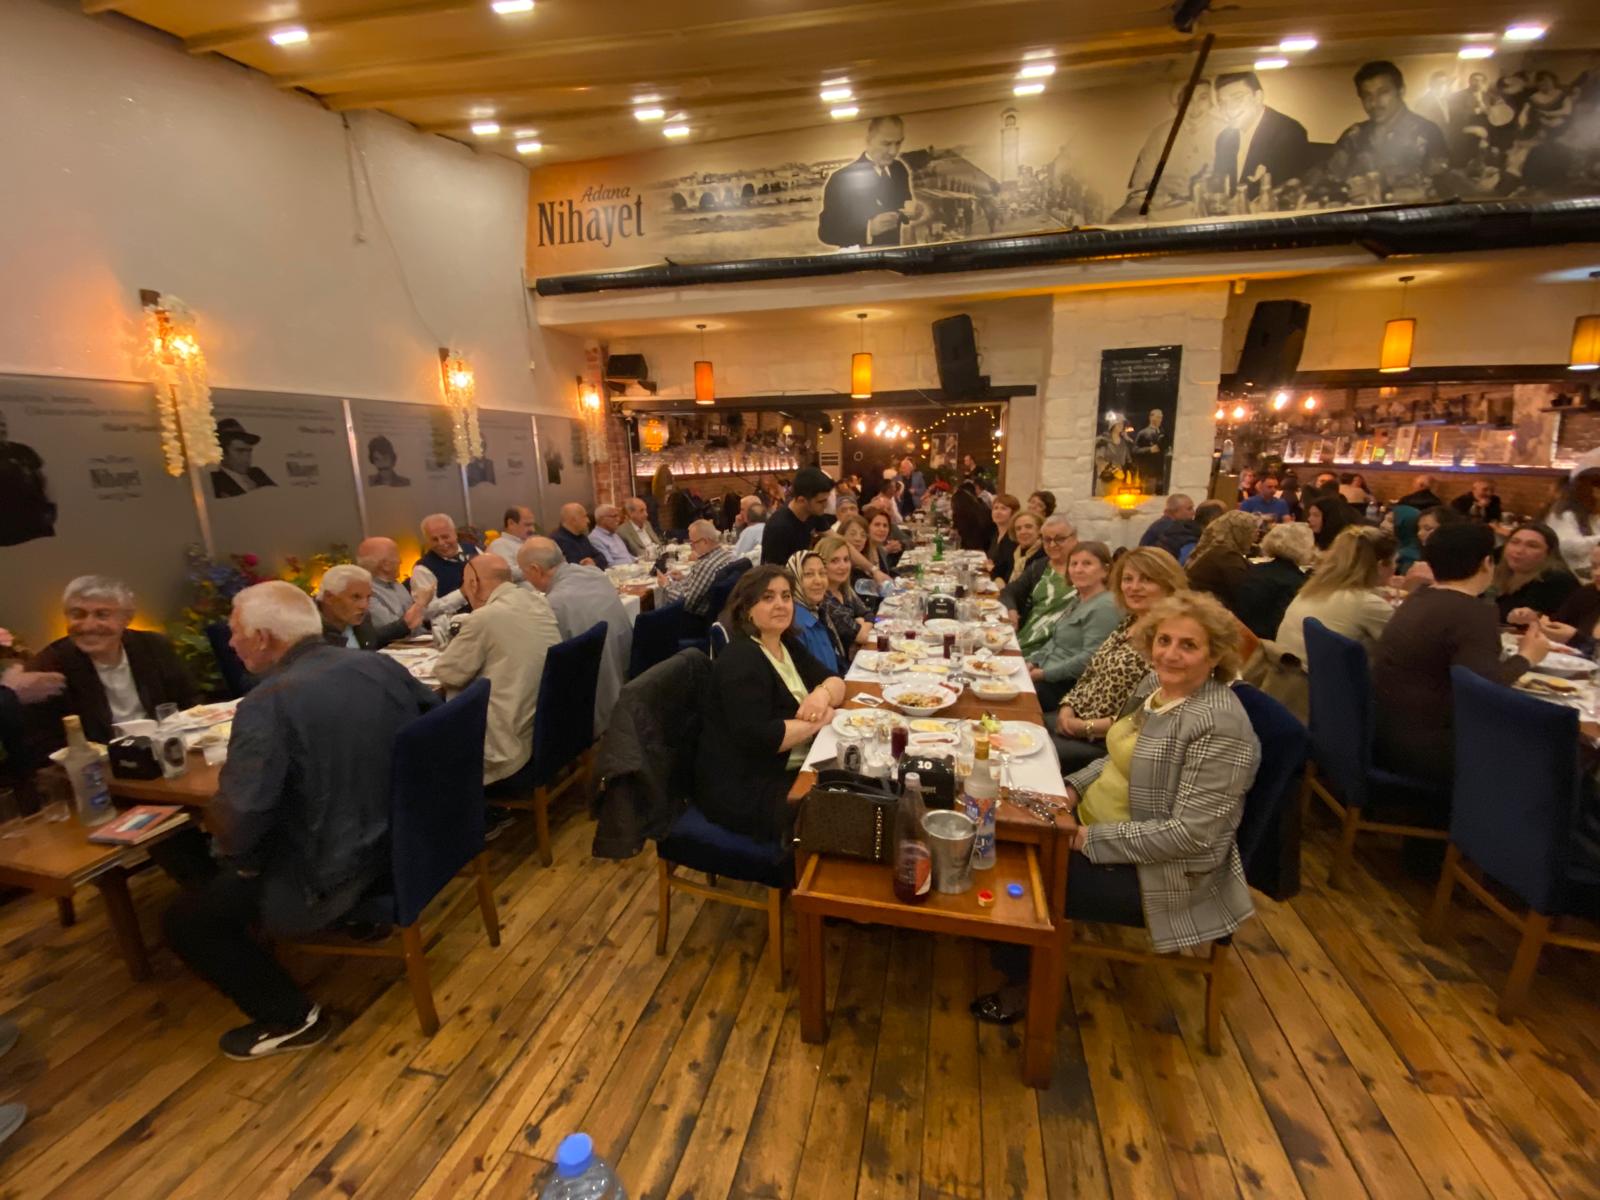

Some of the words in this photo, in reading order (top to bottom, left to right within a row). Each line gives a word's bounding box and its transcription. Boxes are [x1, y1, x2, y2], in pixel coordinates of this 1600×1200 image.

[580, 184, 631, 203] Adana
[537, 194, 645, 248] Nihayet
[917, 760, 933, 770] 10
